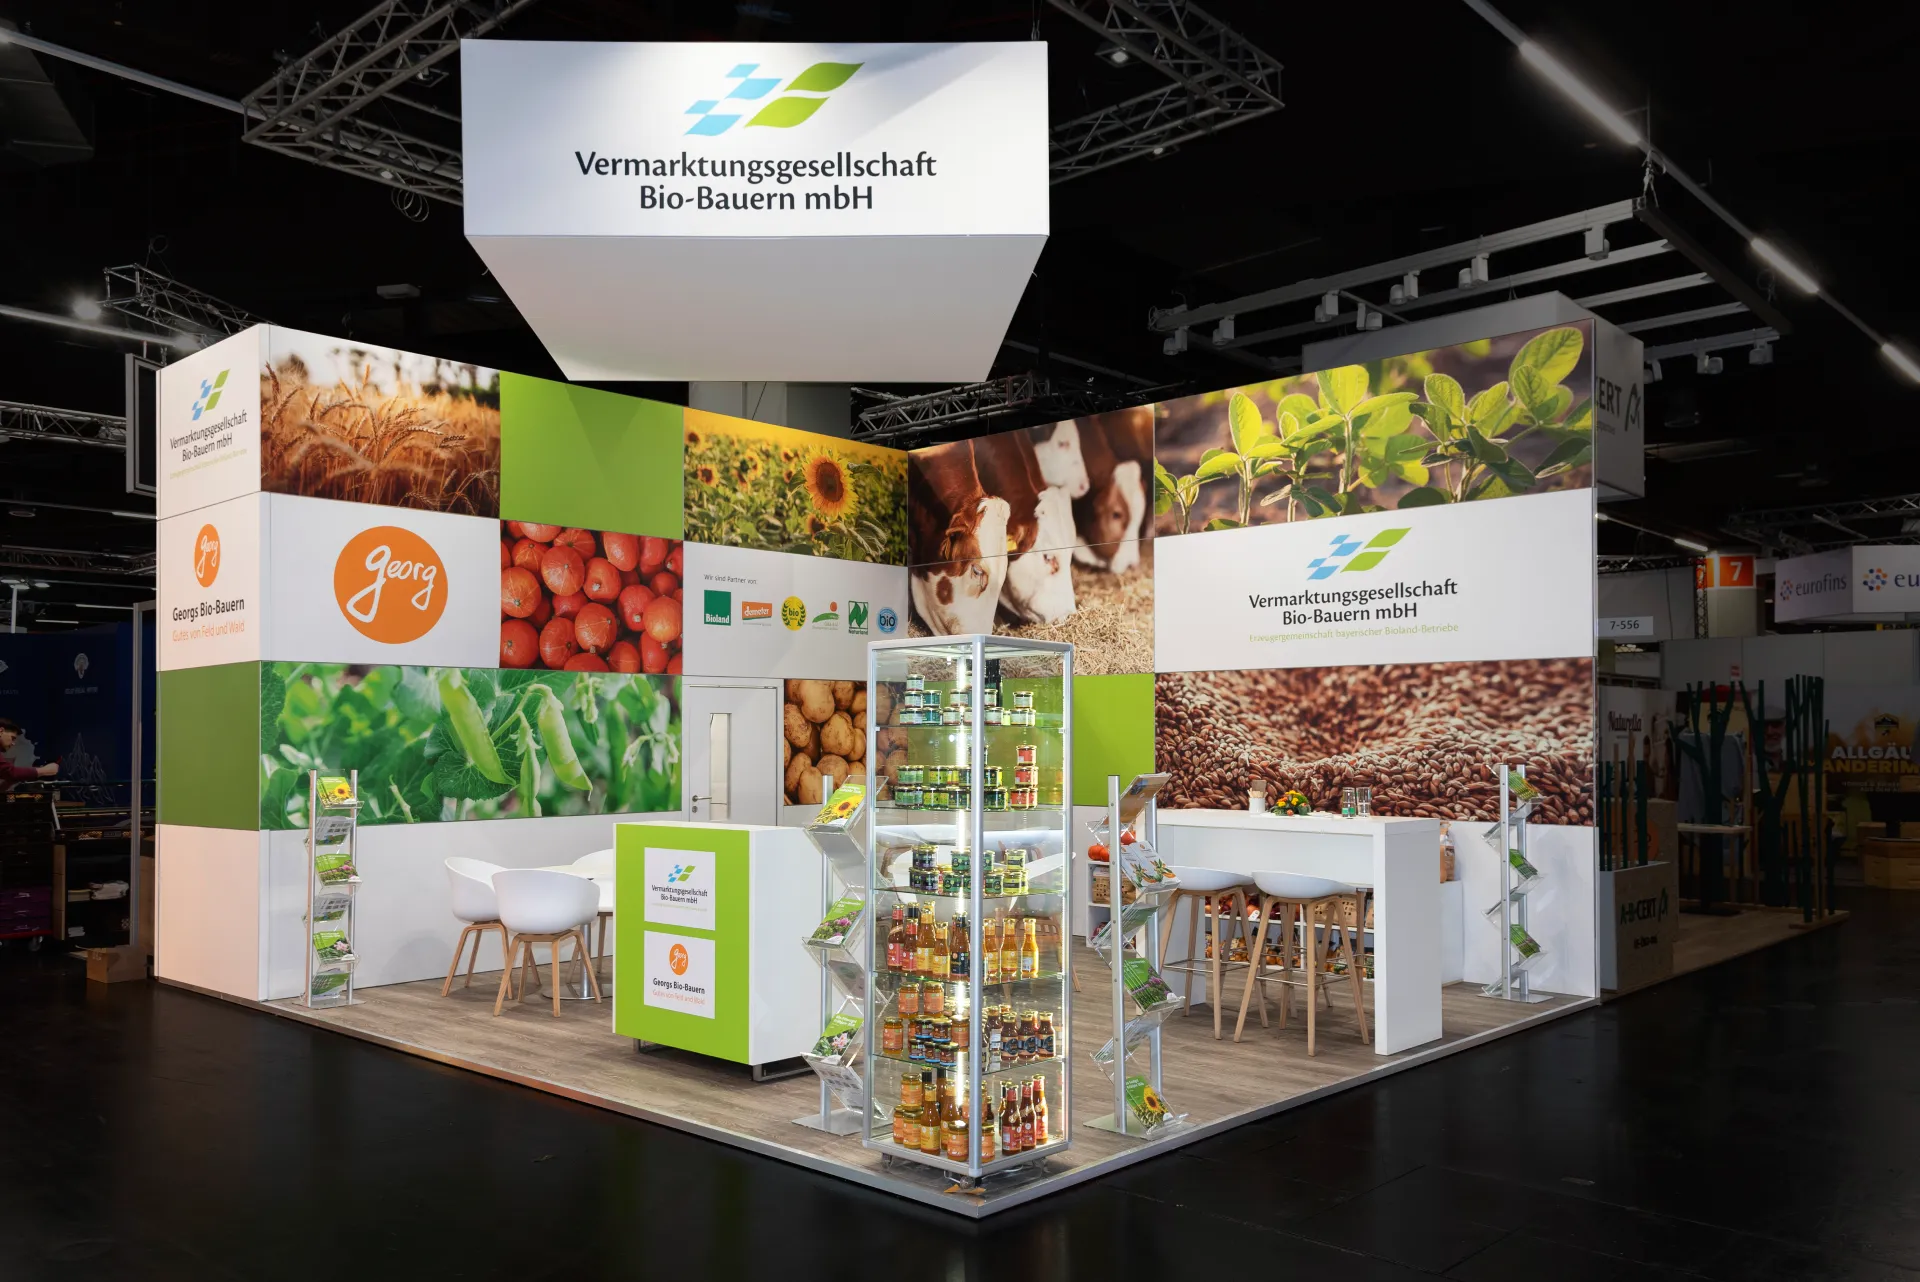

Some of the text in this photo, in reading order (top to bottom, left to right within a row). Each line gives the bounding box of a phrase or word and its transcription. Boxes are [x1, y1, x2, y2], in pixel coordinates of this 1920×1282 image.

[575, 151, 937, 185] Vermarktungsgesellschaft
[640, 185, 873, 210] Bio-Bauern mbH
[1596, 376, 1622, 418] ERT
[169, 409, 247, 450] Vermarktungsgesellschaft
[182, 433, 233, 462] Bio-Bauern mbH
[728, 576, 746, 584] Partner
[1730, 561, 1743, 581] 7
[346, 544, 437, 623] georg
[1249, 578, 1458, 608] Vermarktungsgesellschaft
[1795, 573, 1847, 596] eurofins
[172, 598, 245, 622] Georgs Bio-Bauern
[705, 613, 730, 624] Bioland
[788, 608, 799, 617] bio
[1283, 602, 1418, 626] Bio-Bauern mbH
[1249, 623, 1459, 643] Erzeugergemeinschaft bayerischer Bioland-Betriebe
[1610, 620, 1640, 630] 7-556
[652, 885, 708, 897] Vermarktungsgesellschaft
[653, 978, 705, 995] Georgs Bio-Bauern
